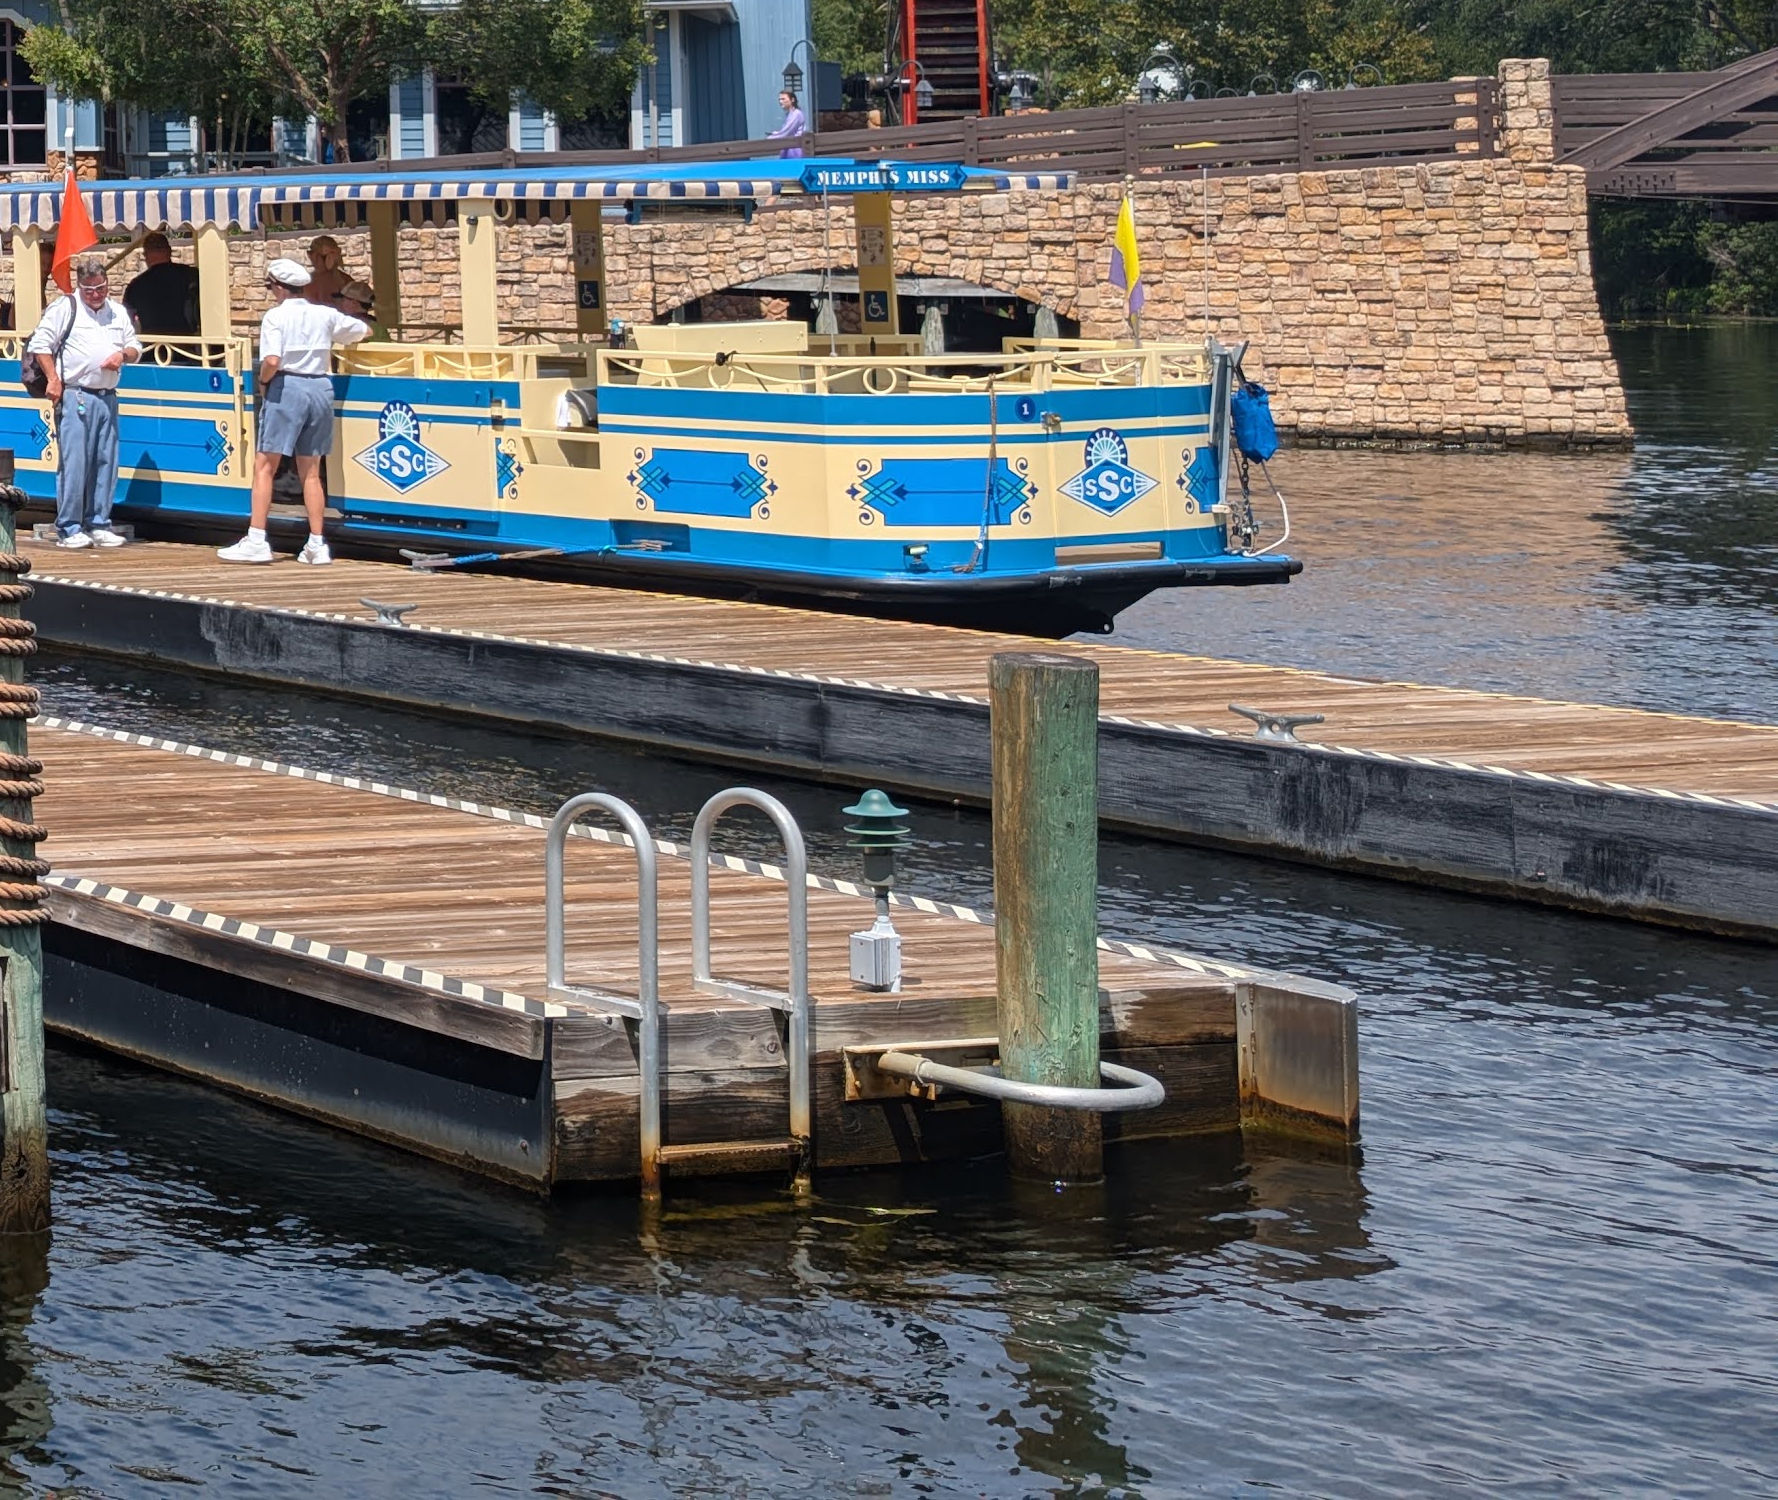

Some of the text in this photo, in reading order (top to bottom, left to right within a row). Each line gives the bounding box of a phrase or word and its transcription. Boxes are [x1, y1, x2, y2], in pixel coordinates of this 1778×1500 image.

[817, 169, 950, 185] MEMPHIS MISS
[1022, 403, 1029, 415] 1
[378, 444, 424, 478] SSC
[1085, 469, 1133, 502] SSC
